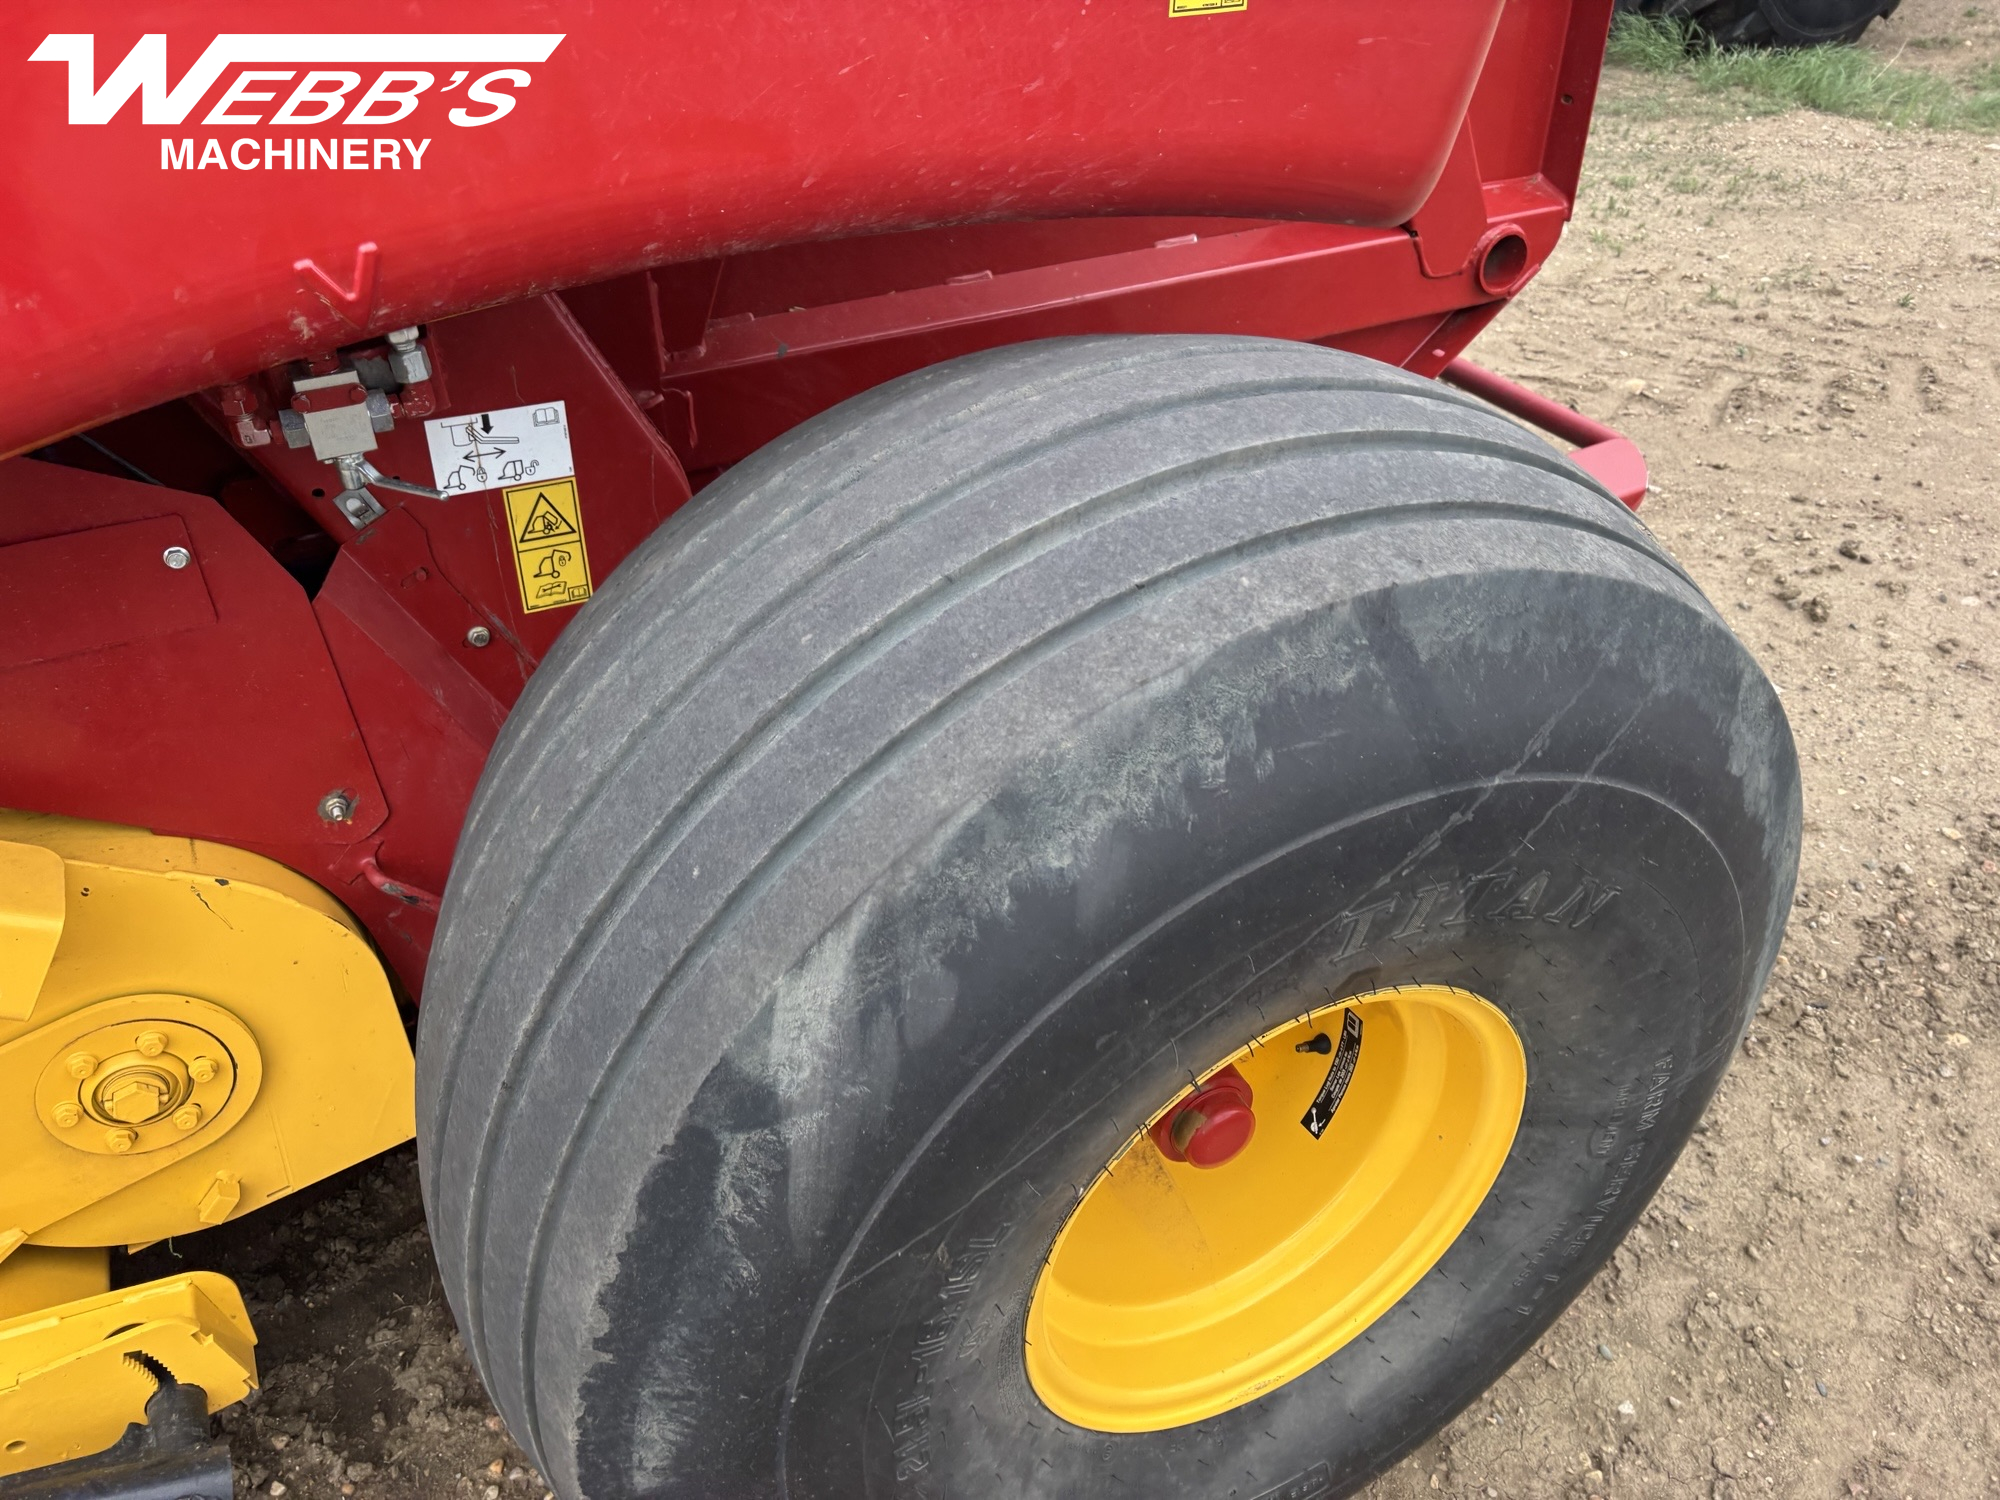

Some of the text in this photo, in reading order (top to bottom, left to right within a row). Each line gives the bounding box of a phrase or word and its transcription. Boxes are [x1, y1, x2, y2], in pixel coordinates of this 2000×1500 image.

[1330, 868, 1622, 964] TITAN
[1636, 1054, 1674, 1132] FARM
[1562, 1142, 1646, 1258] SERVICE
